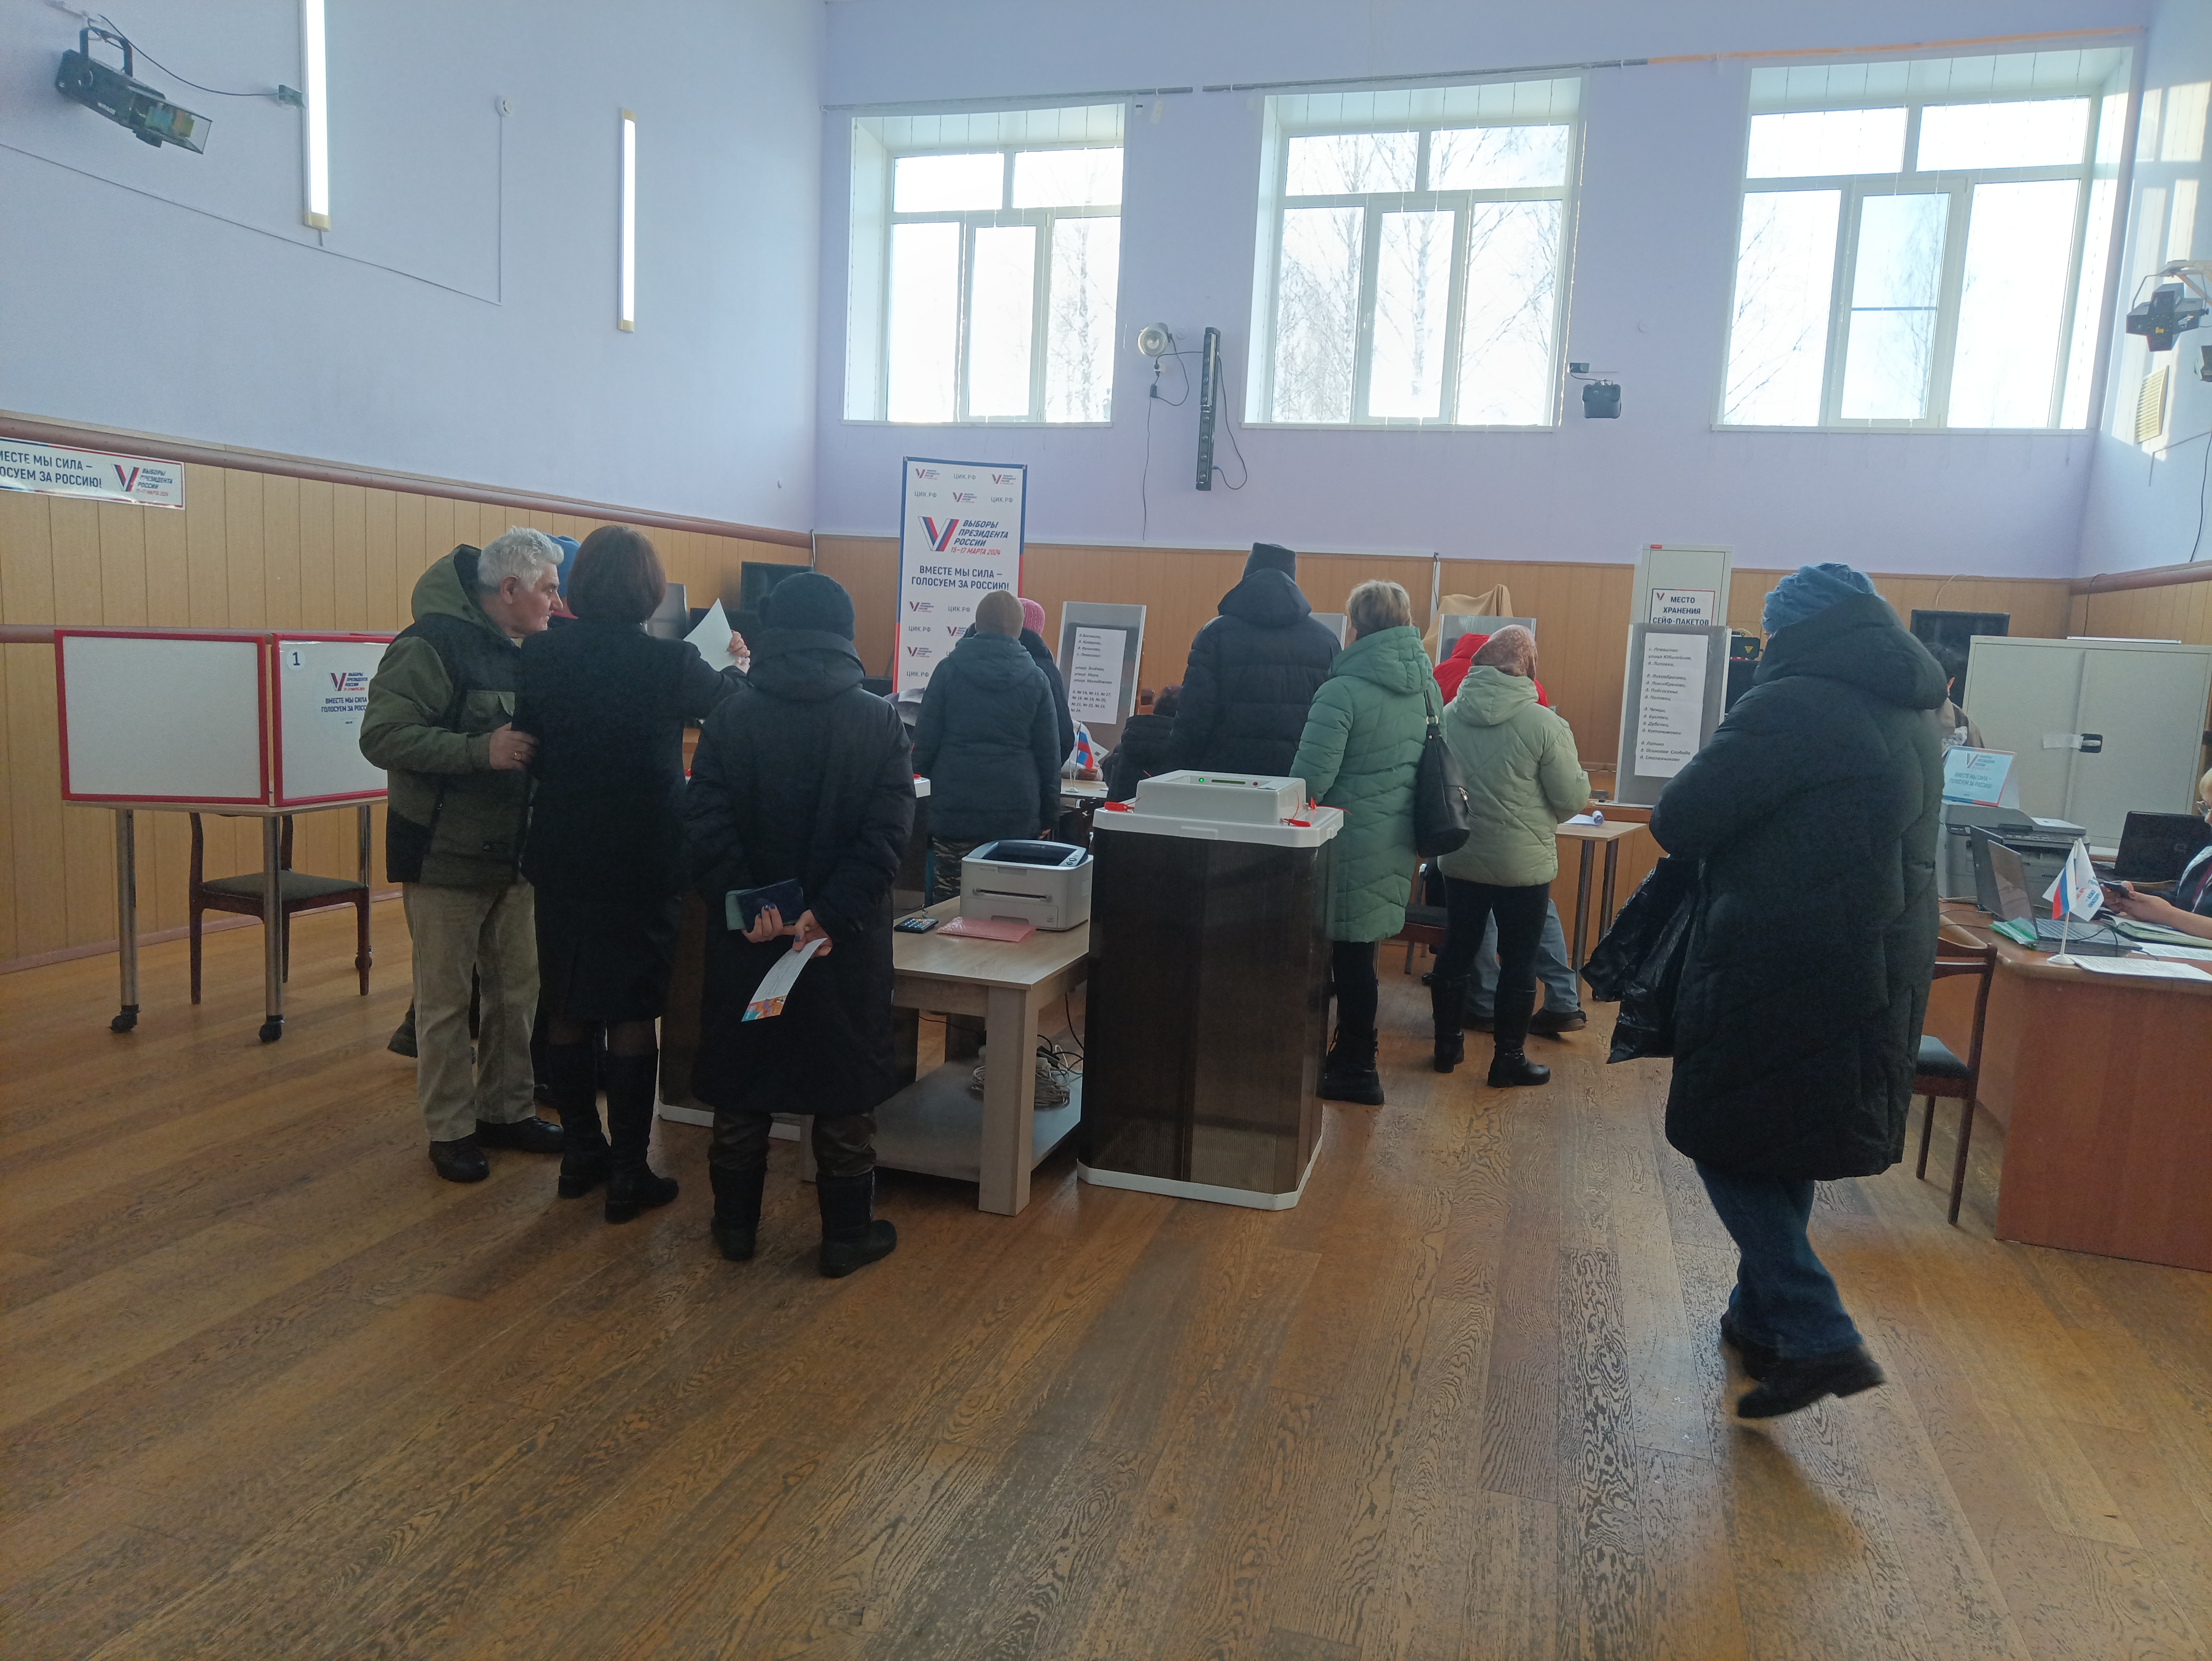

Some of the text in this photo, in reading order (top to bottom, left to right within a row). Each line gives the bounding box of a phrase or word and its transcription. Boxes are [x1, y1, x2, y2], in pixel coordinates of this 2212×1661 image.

[34, 455, 52, 467] МЫ
[56, 458, 83, 471] СИЛА
[40, 471, 52, 482] ЗА
[55, 473, 101, 487] РОССИЮ!
[962, 520, 999, 528] ВЫБОРЫ
[958, 529, 1008, 539] ПРЕЗИДЕНТА
[954, 538, 987, 547] РОССИИ
[919, 565, 952, 576] ВМЕСТЕ
[955, 568, 969, 576] МЫ
[972, 569, 994, 578] СИЛА
[912, 576, 1009, 590] ГОЛОСУЕМ ЗА РОССИЮ!
[1653, 616, 1709, 626] СЕЙФ-ПАКЕТОВ
[292, 652, 300, 666] 1
